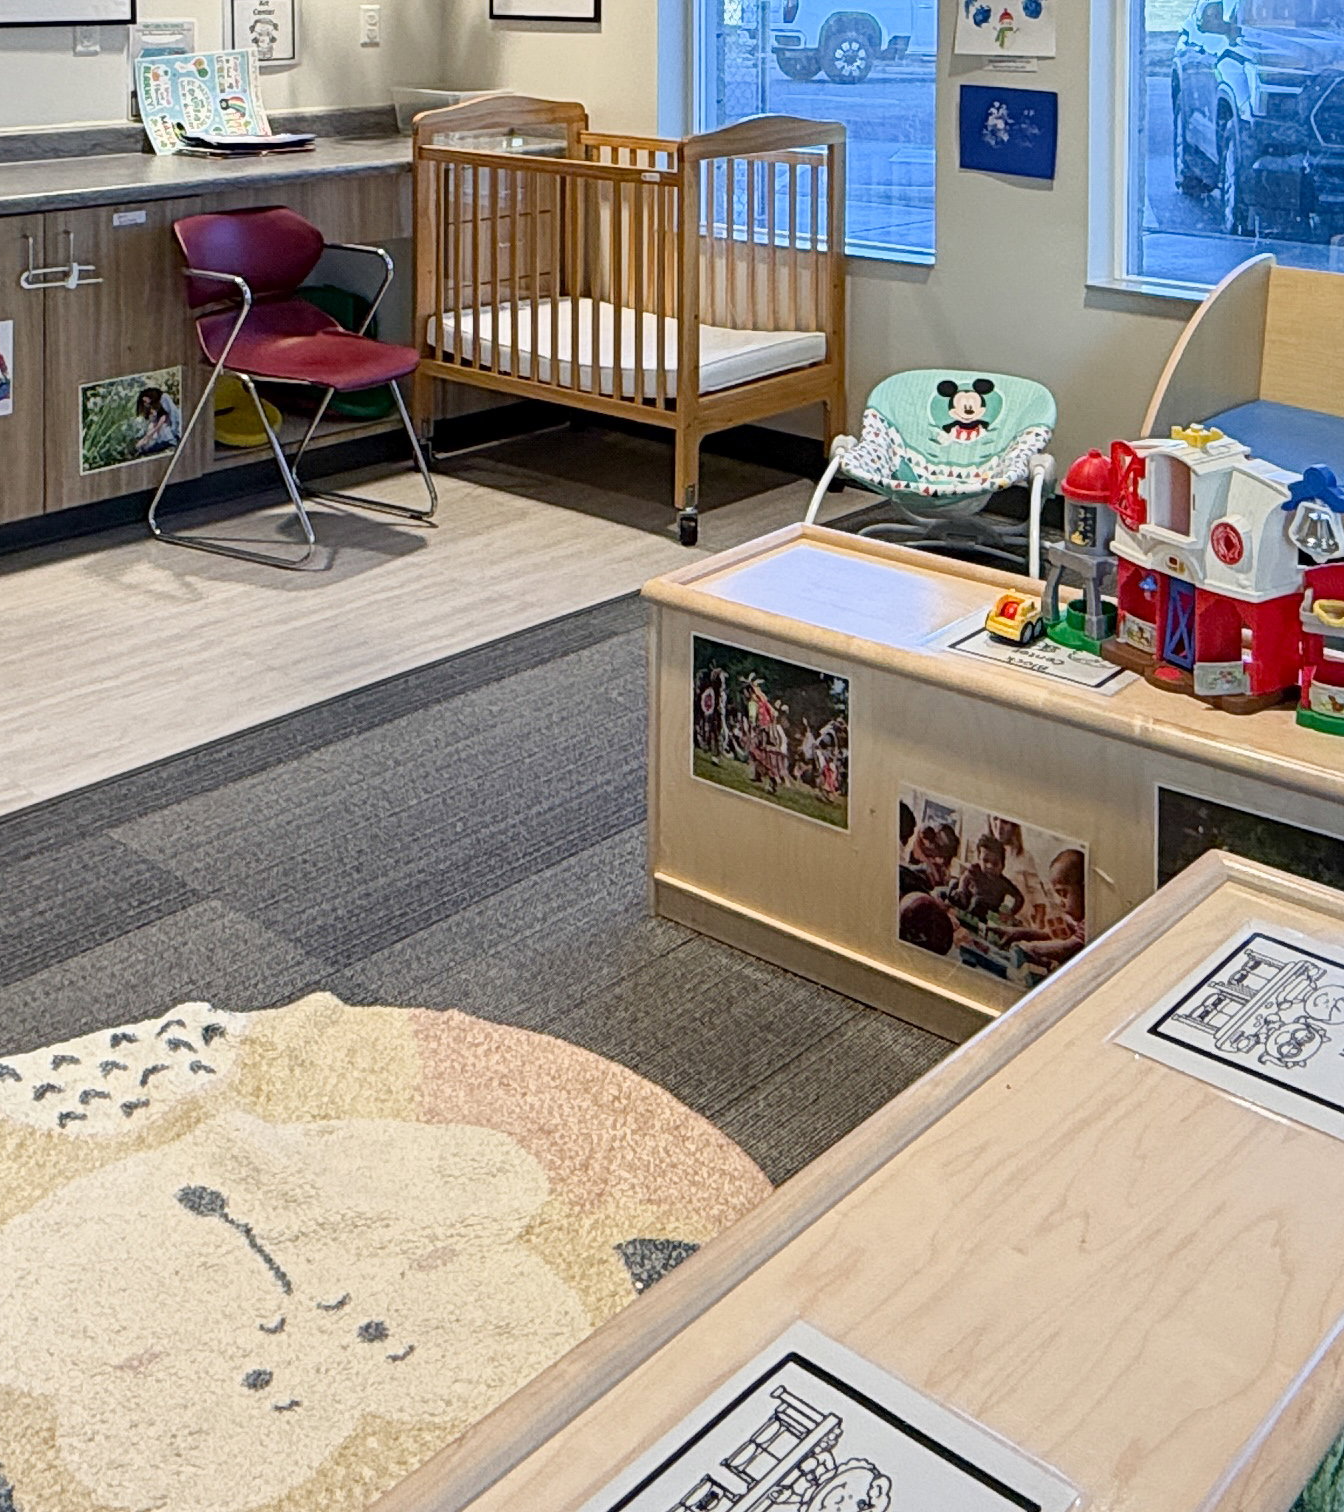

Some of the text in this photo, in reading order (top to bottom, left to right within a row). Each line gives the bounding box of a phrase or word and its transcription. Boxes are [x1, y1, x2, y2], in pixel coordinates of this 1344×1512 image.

[253, 8, 275, 16] Center
[1006, 656, 1049, 671] Block
[1011, 648, 1065, 666] Center
